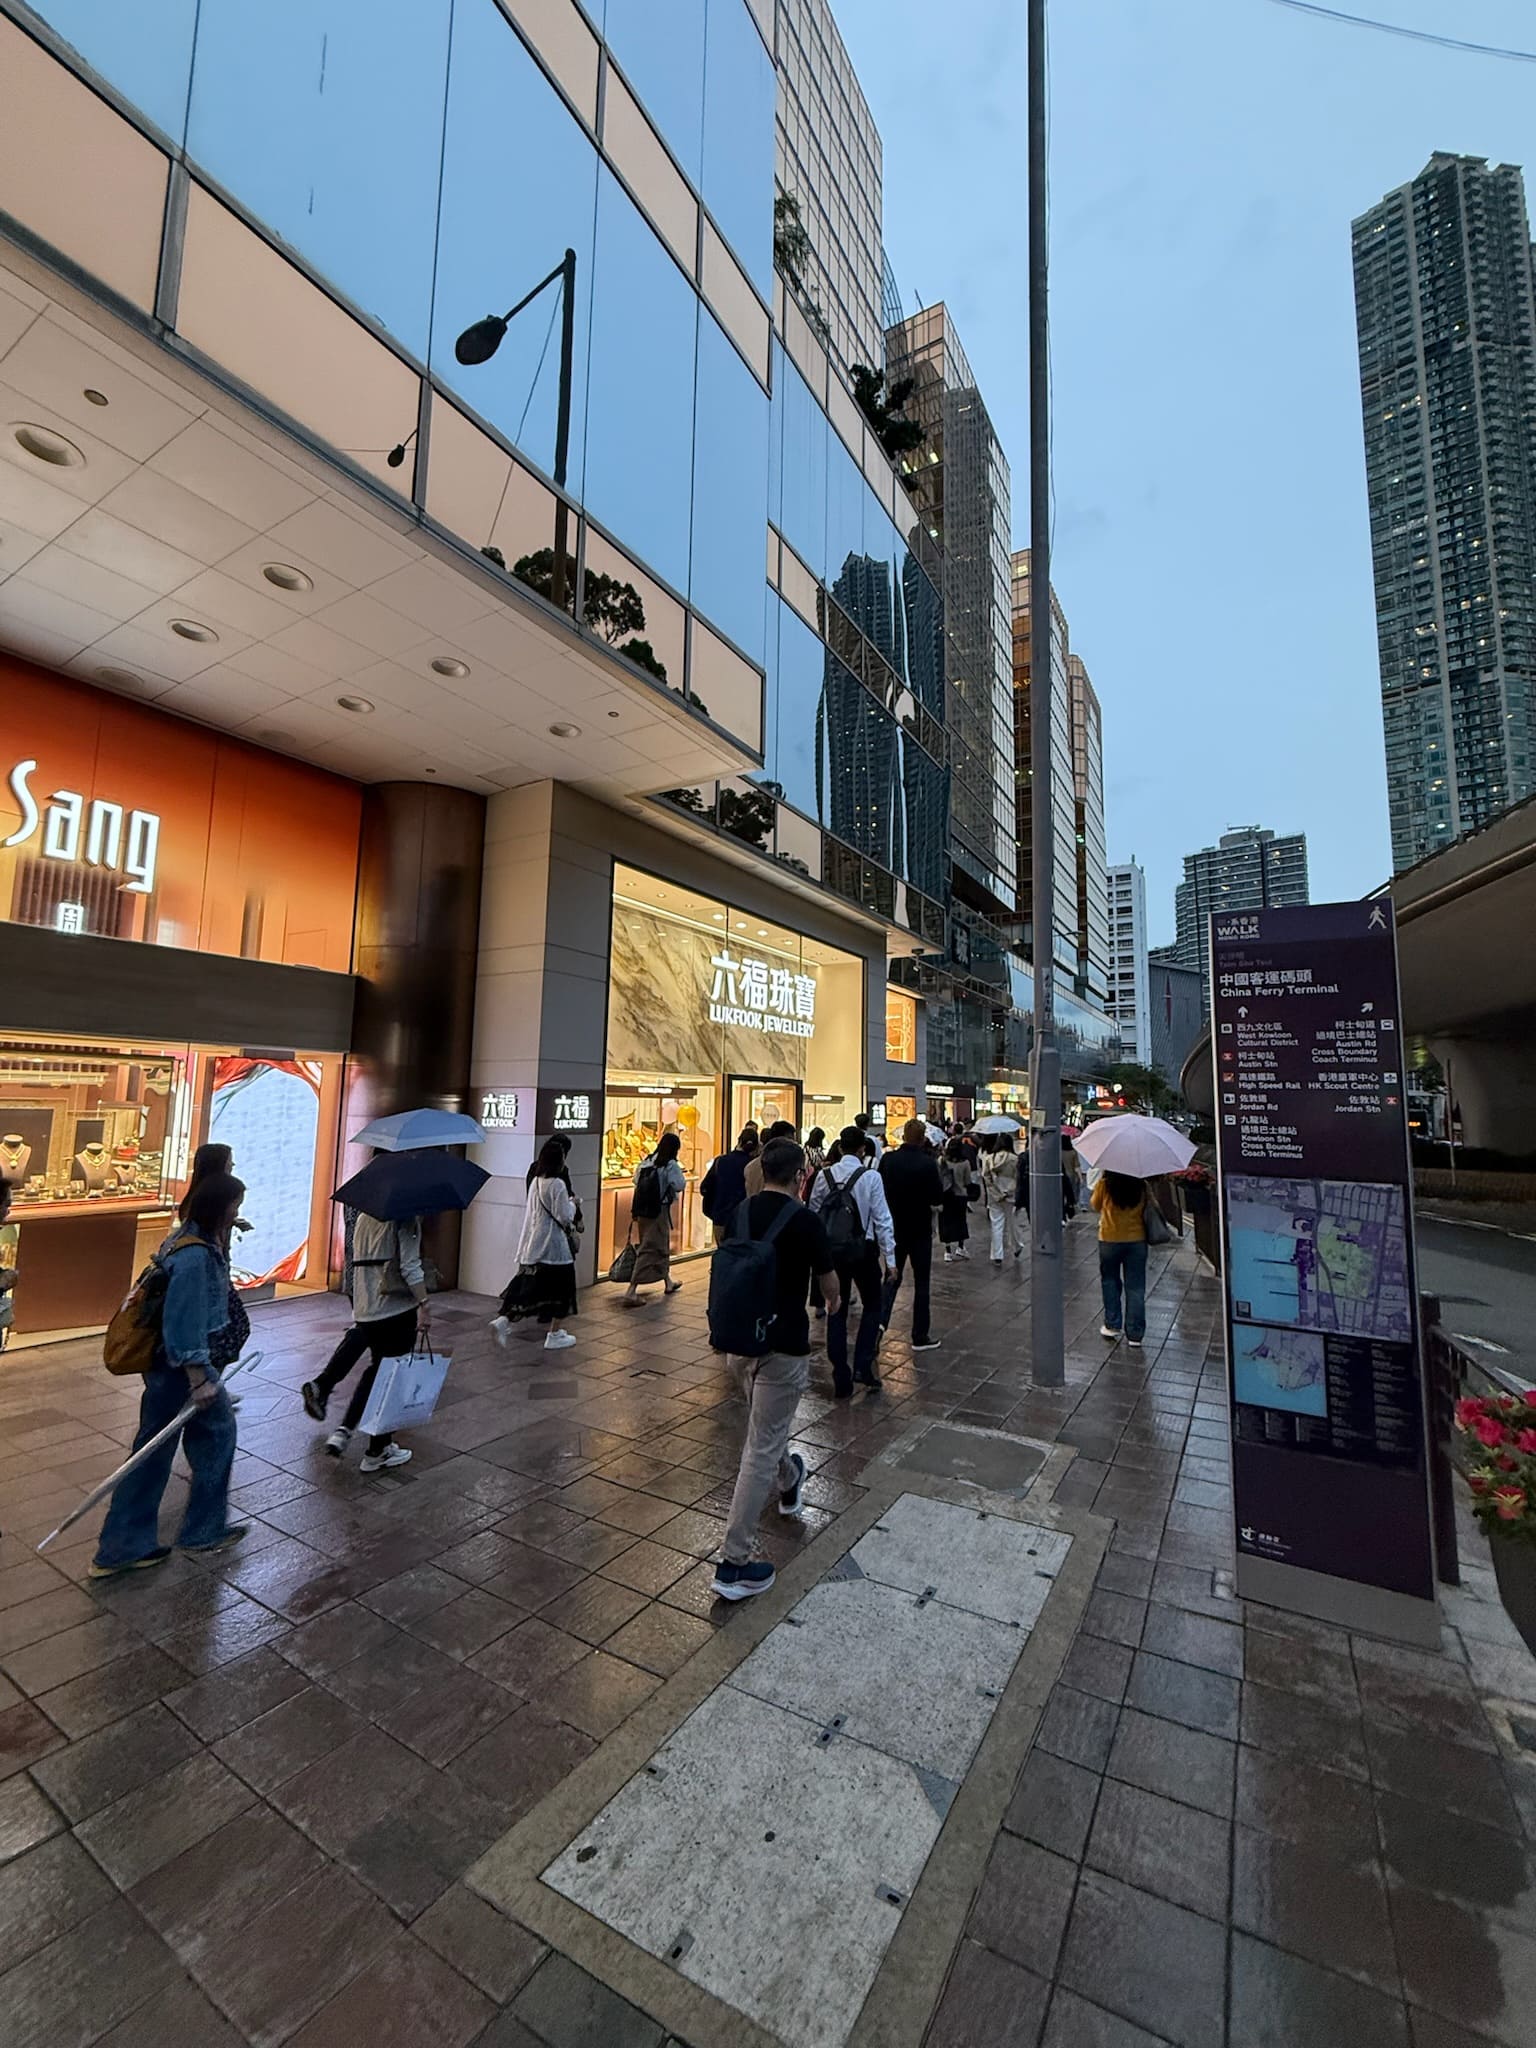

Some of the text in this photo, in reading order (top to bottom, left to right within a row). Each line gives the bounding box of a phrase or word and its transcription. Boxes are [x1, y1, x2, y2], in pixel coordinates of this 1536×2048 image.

[5, 760, 161, 893] Sang
[1217, 924, 1259, 936] WALK
[1219, 969, 1312, 986] 中國客運碼頭
[710, 949, 817, 1021] 六福珠寶
[1220, 984, 1339, 998] China Ferry Terminal
[709, 1003, 815, 1039] LUKFOOK JEWELLERY
[1237, 1038, 1299, 1047] Cultural District
[1335, 1039, 1377, 1048] Austin Rd
[1311, 1047, 1378, 1056] Cross Boundary
[1312, 1055, 1378, 1063] Coach Terminus
[1238, 1060, 1279, 1068] Austin Stn
[1238, 1081, 1302, 1090] High Speed Rail
[1308, 1081, 1380, 1090] HK Scout Centre
[481, 1093, 517, 1118] 六福
[554, 1094, 590, 1119] 六福
[1239, 1103, 1279, 1111] Jordan Rd
[1334, 1104, 1382, 1113] Jordan Stn
[1241, 1134, 1292, 1143] Kowloon Stn
[1241, 1141, 1304, 1152] Cross Boundary
[1241, 1149, 1304, 1159] Coach Terminus
